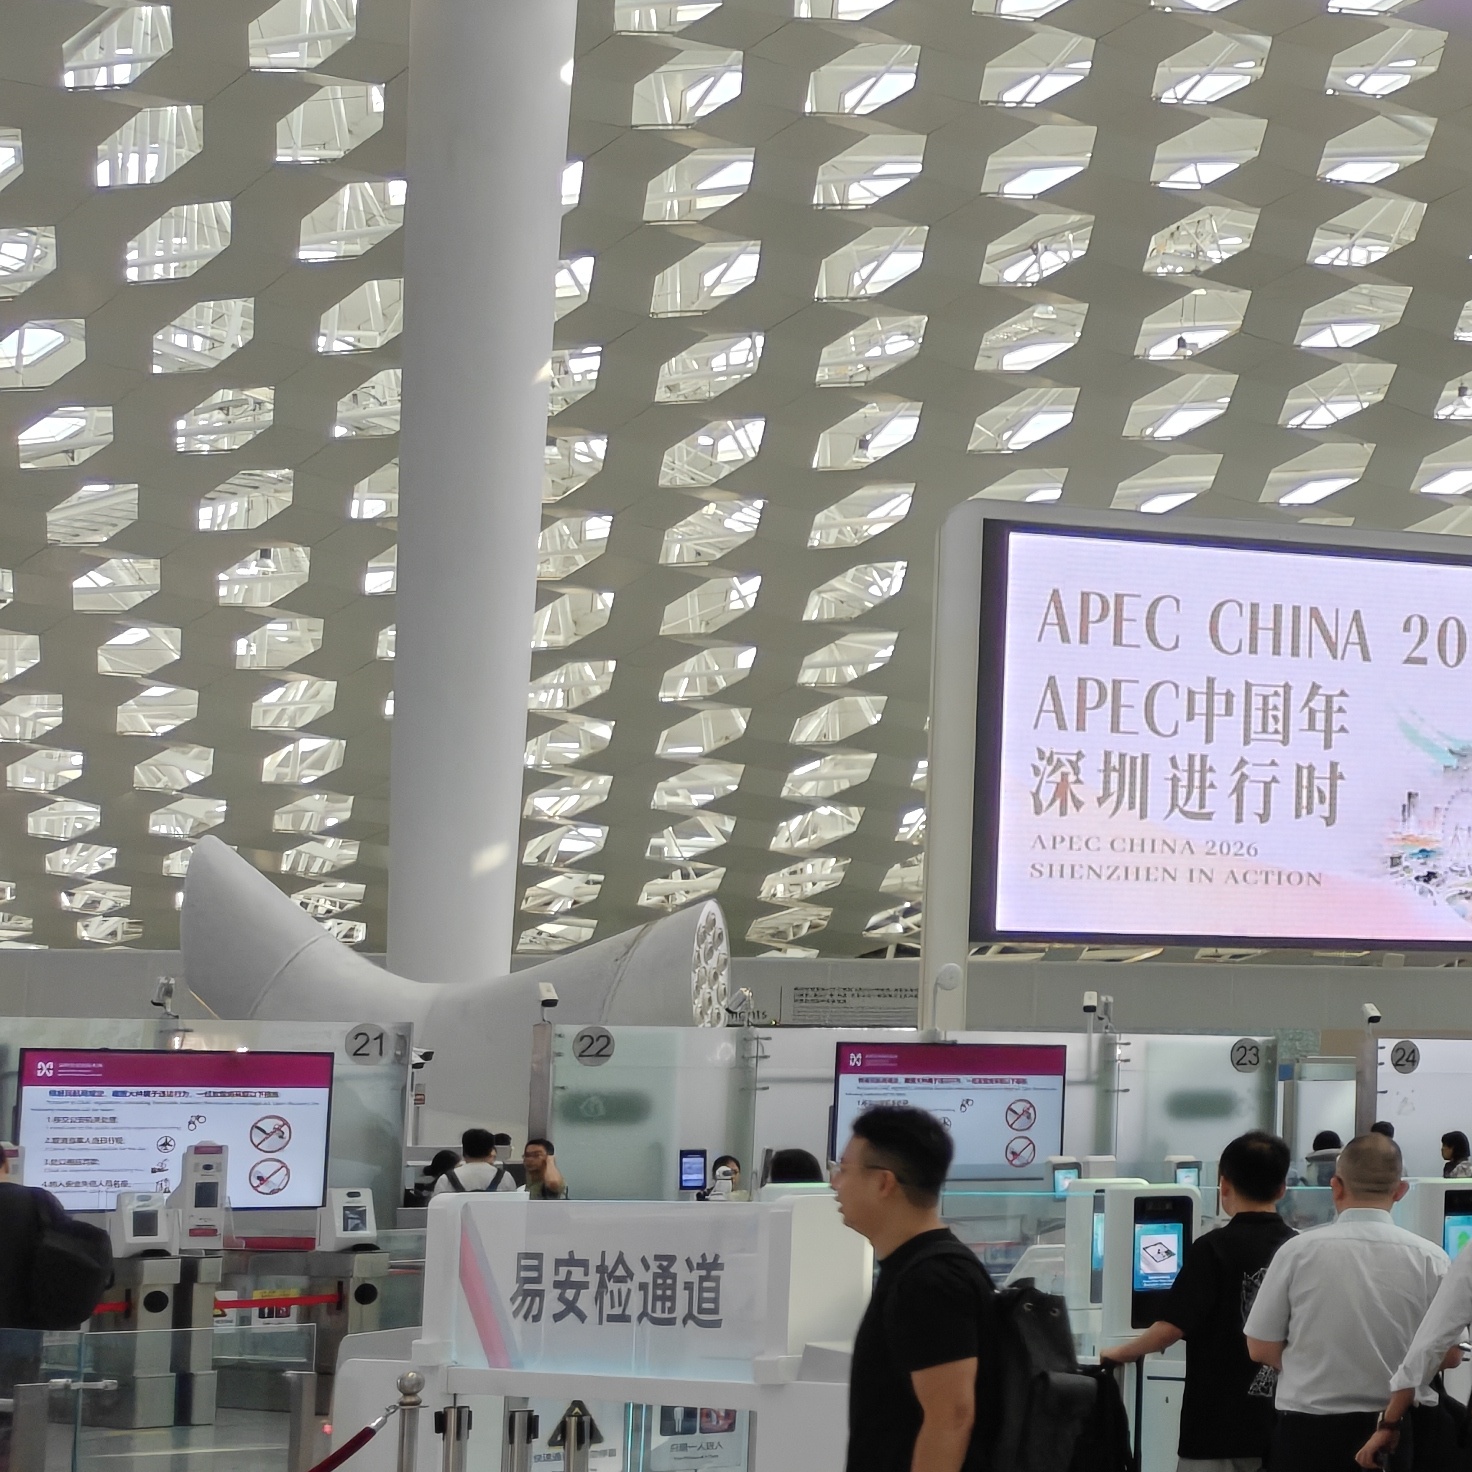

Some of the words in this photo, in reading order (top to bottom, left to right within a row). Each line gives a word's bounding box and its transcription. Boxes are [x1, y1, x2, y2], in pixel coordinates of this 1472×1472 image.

[1037, 587, 1181, 653] APEC
[1209, 598, 1372, 664] CHINA
[1033, 674, 1350, 751] APEC中国年
[1030, 747, 1345, 827] 深圳进行时
[1030, 834, 1100, 852] APEC
[1110, 837, 1195, 856] CHINA
[1205, 840, 1258, 857] 2026
[1030, 862, 1177, 883] SHENZHEN
[1189, 868, 1214, 883] IN
[1224, 868, 1322, 886] ACTION
[352, 1031, 386, 1057] 21
[579, 1035, 612, 1059] 22
[1236, 1045, 1261, 1067] 23
[1392, 1047, 1418, 1067] 24
[510, 1251, 725, 1328] 易安检通道
